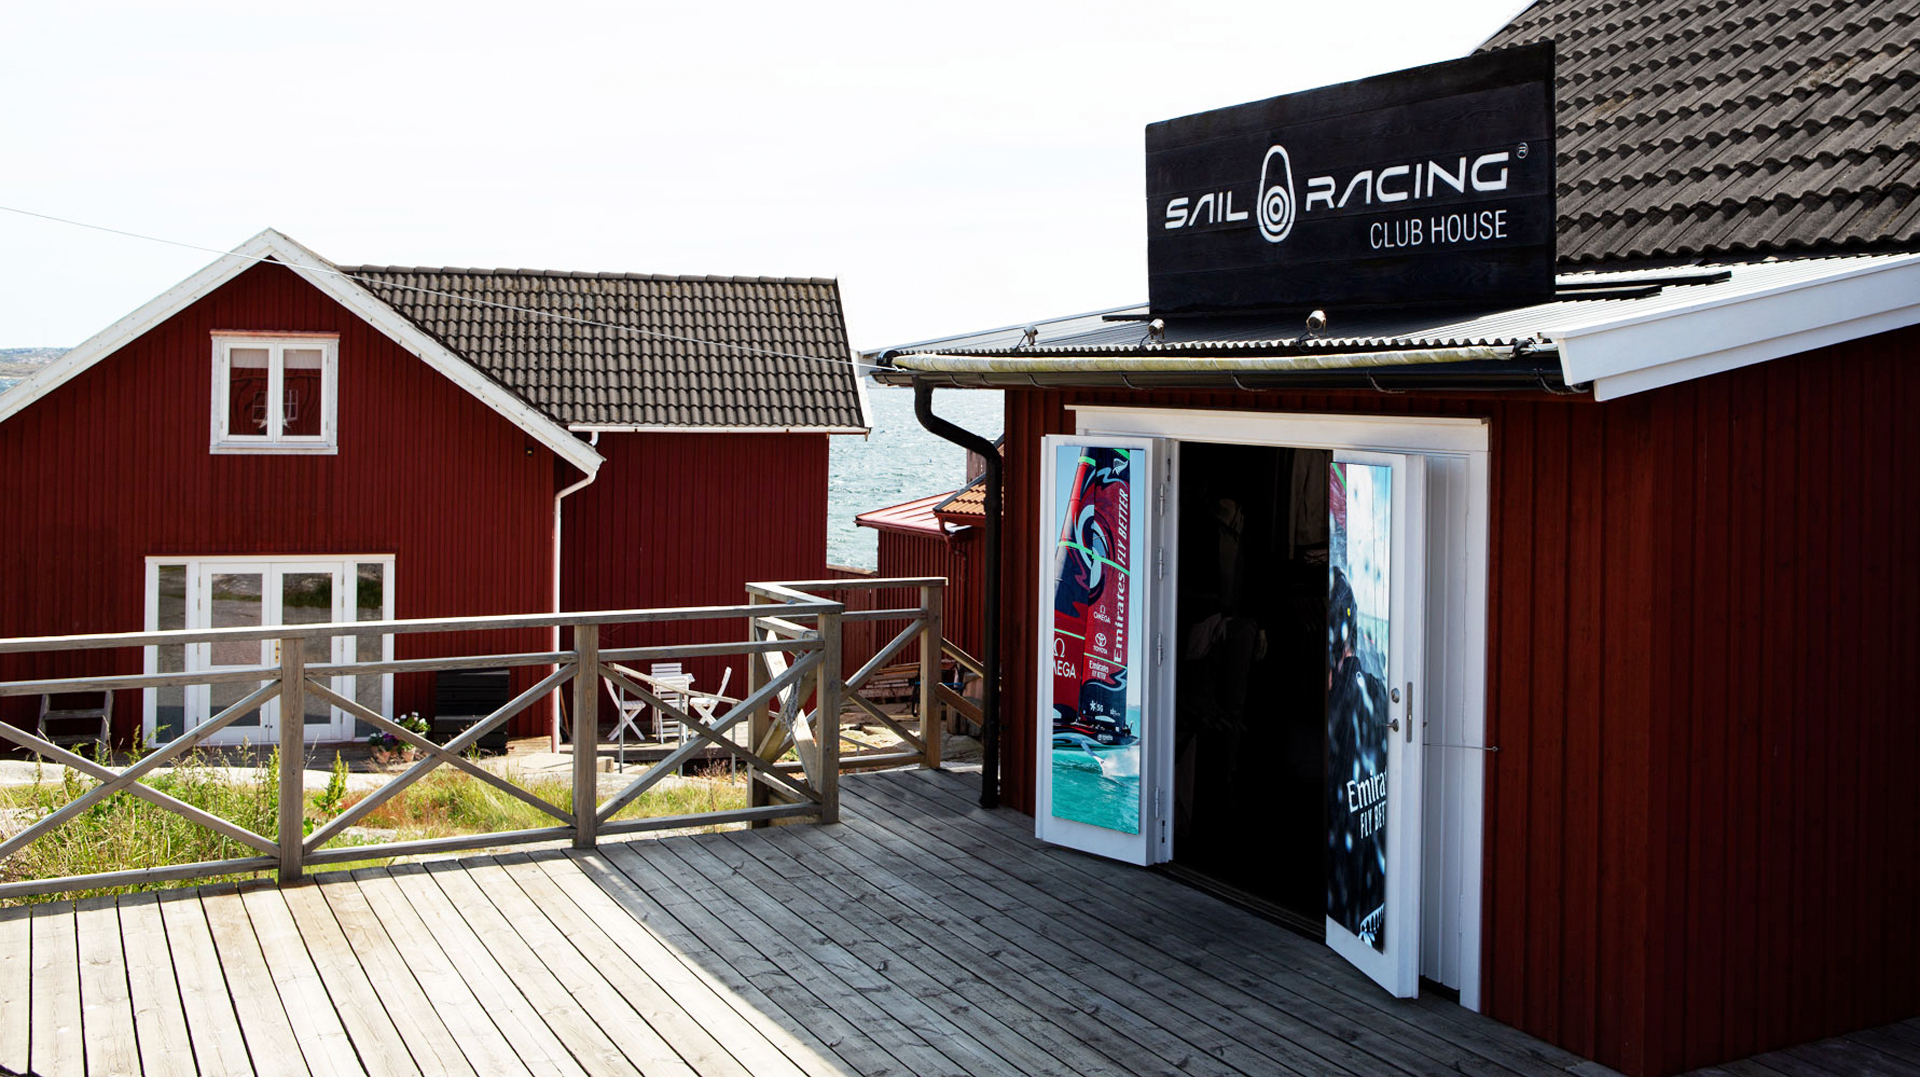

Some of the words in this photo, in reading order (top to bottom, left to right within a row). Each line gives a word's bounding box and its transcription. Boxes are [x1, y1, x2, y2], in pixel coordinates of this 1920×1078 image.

[1165, 190, 1249, 230] SAIL
[1305, 151, 1509, 212] RACING
[1370, 218, 1424, 250] CLUB
[1431, 209, 1508, 244] HOUSE
[1118, 487, 1129, 541] BETTER
[1117, 539, 1127, 566] FLY
[1113, 571, 1126, 663] Emirates
[1361, 808, 1372, 839] FLY
